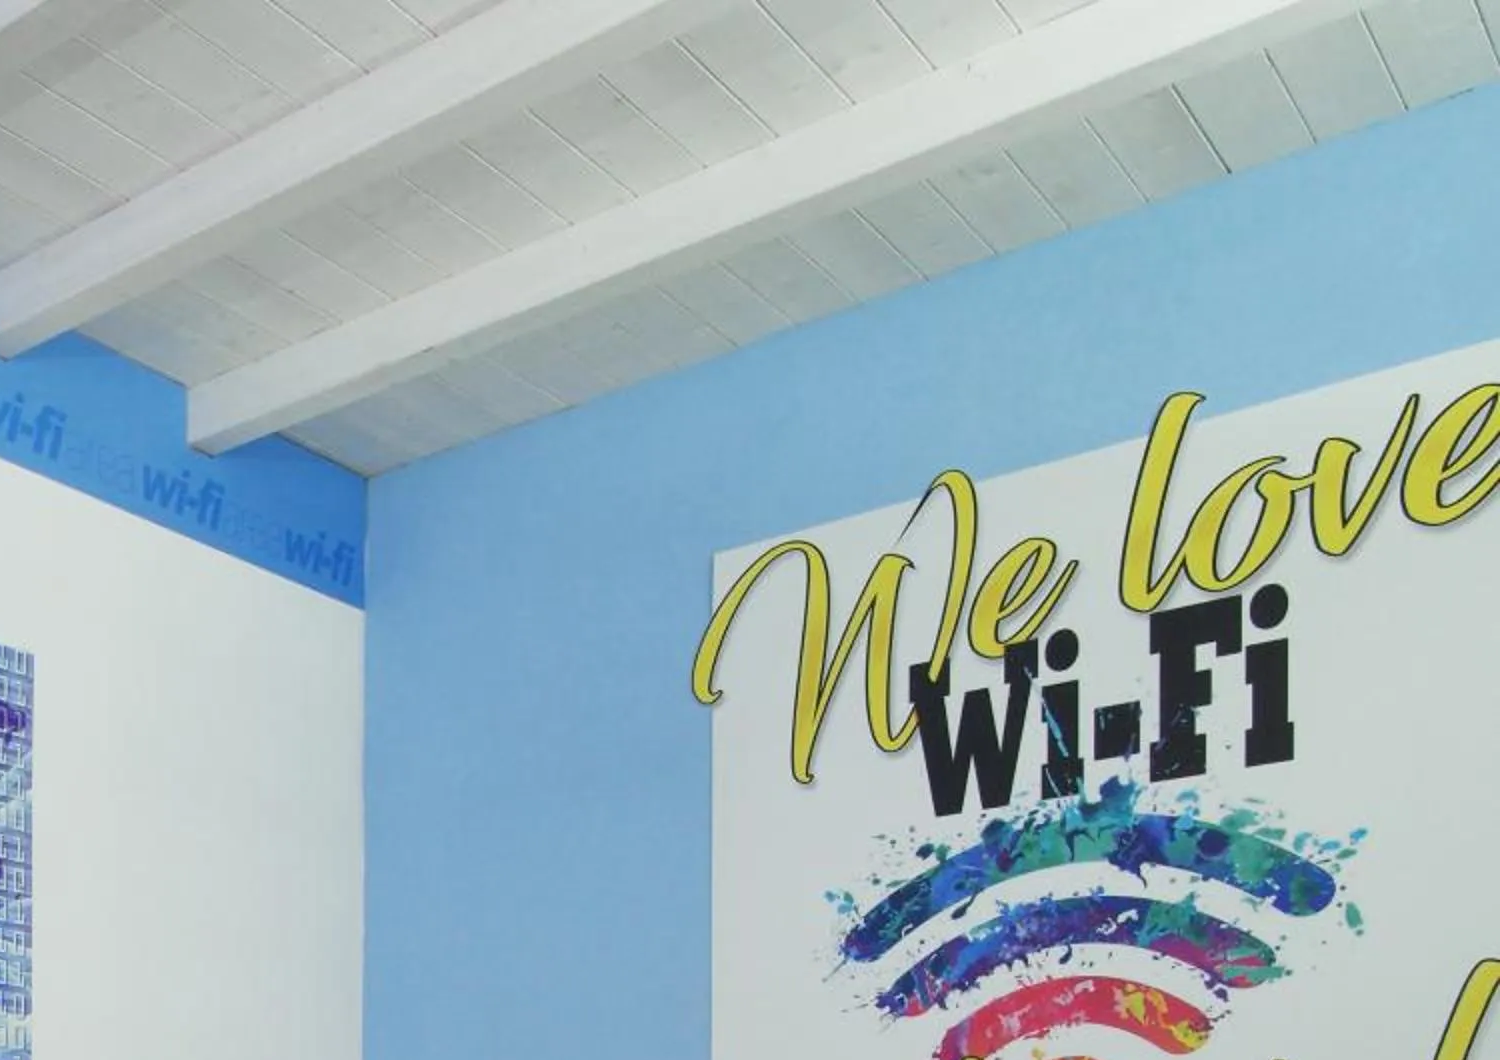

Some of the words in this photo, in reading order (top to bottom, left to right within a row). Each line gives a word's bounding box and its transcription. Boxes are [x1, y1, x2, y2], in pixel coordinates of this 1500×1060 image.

[141, 461, 226, 533] wi-fi
[284, 526, 356, 588] wi-fi
[691, 468, 1079, 784] We
[1118, 383, 1500, 613] love
[909, 582, 1296, 818] Wi-Fi
